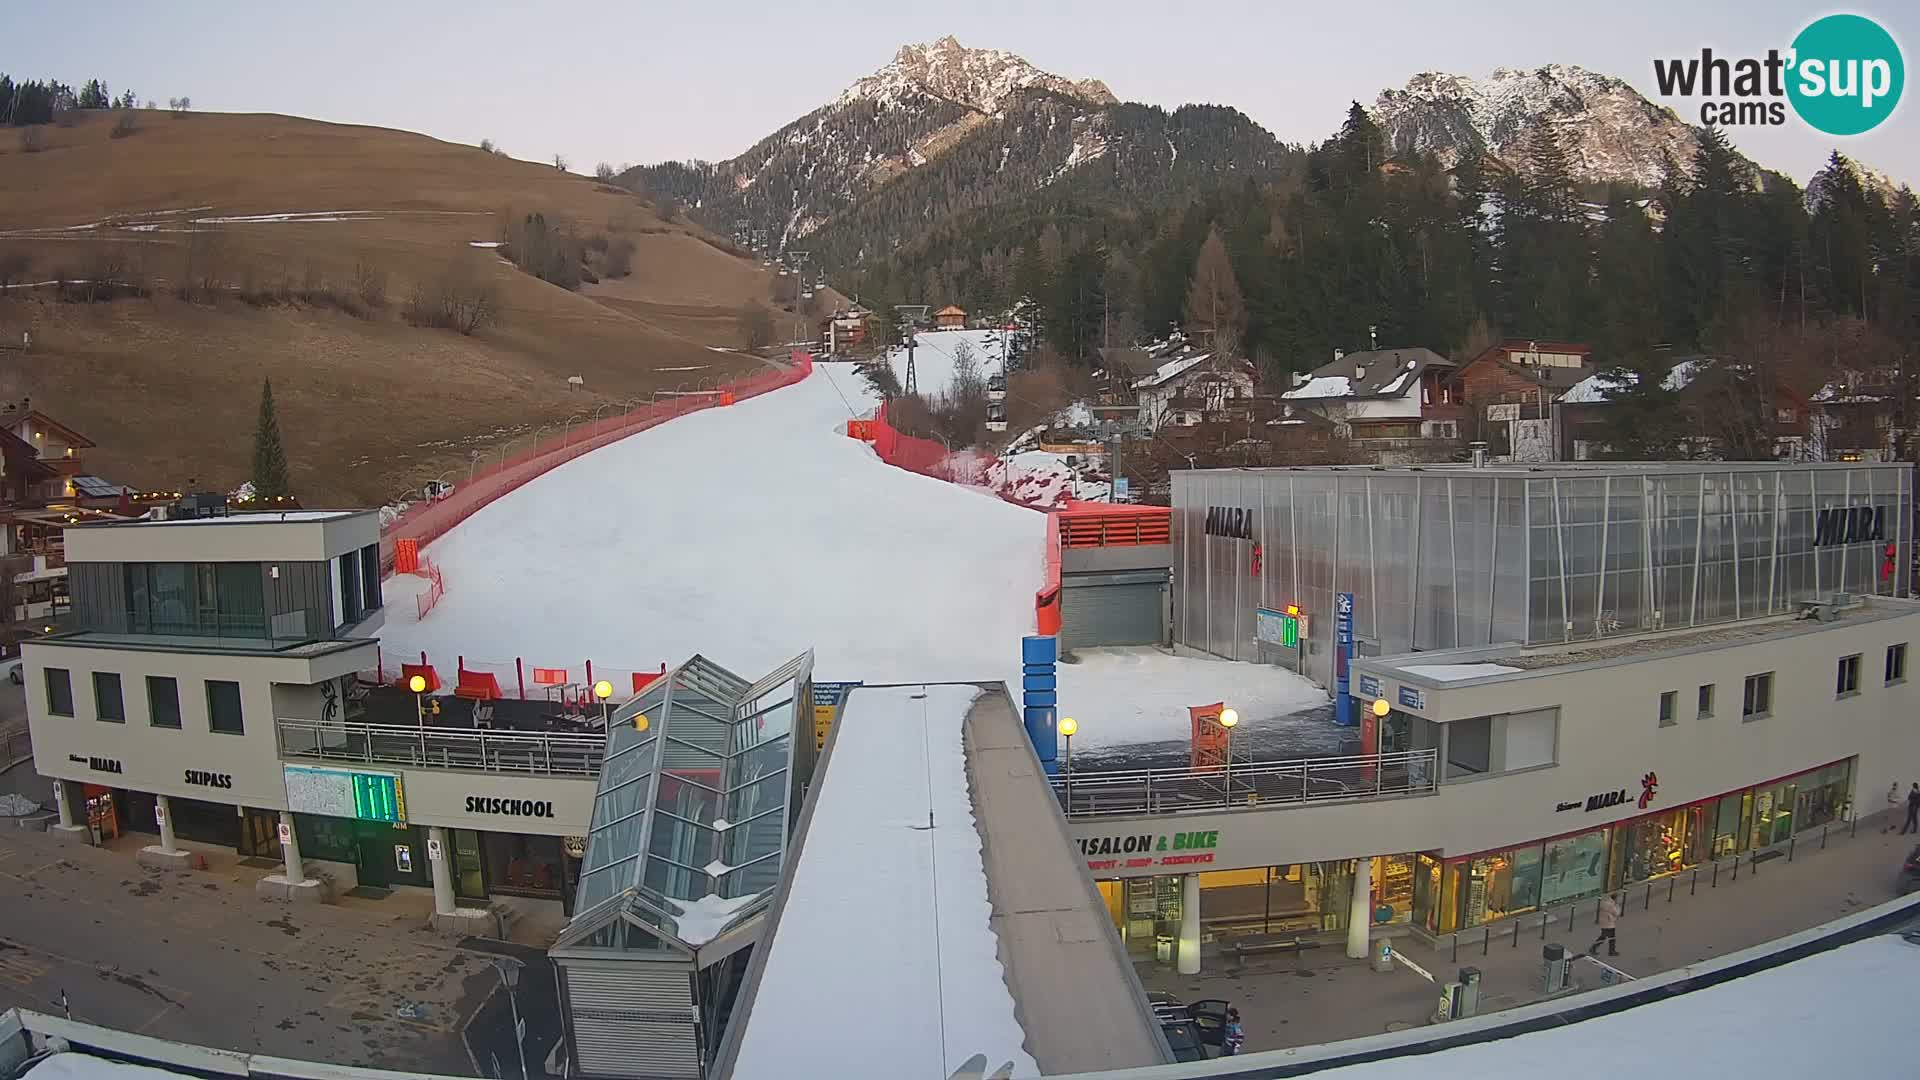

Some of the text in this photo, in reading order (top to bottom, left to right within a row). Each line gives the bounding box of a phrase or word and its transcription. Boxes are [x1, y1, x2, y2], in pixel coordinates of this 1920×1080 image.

[1205, 506, 1252, 540] MIARA
[1814, 507, 1884, 546] MIARA
[89, 757, 122, 774] MIARA
[185, 769, 232, 789] SKIPASS
[466, 796, 554, 818] SKISCHOOL
[1585, 789, 1626, 812] MIARA
[1156, 836, 1167, 851] &
[1173, 831, 1218, 849] BIKE
